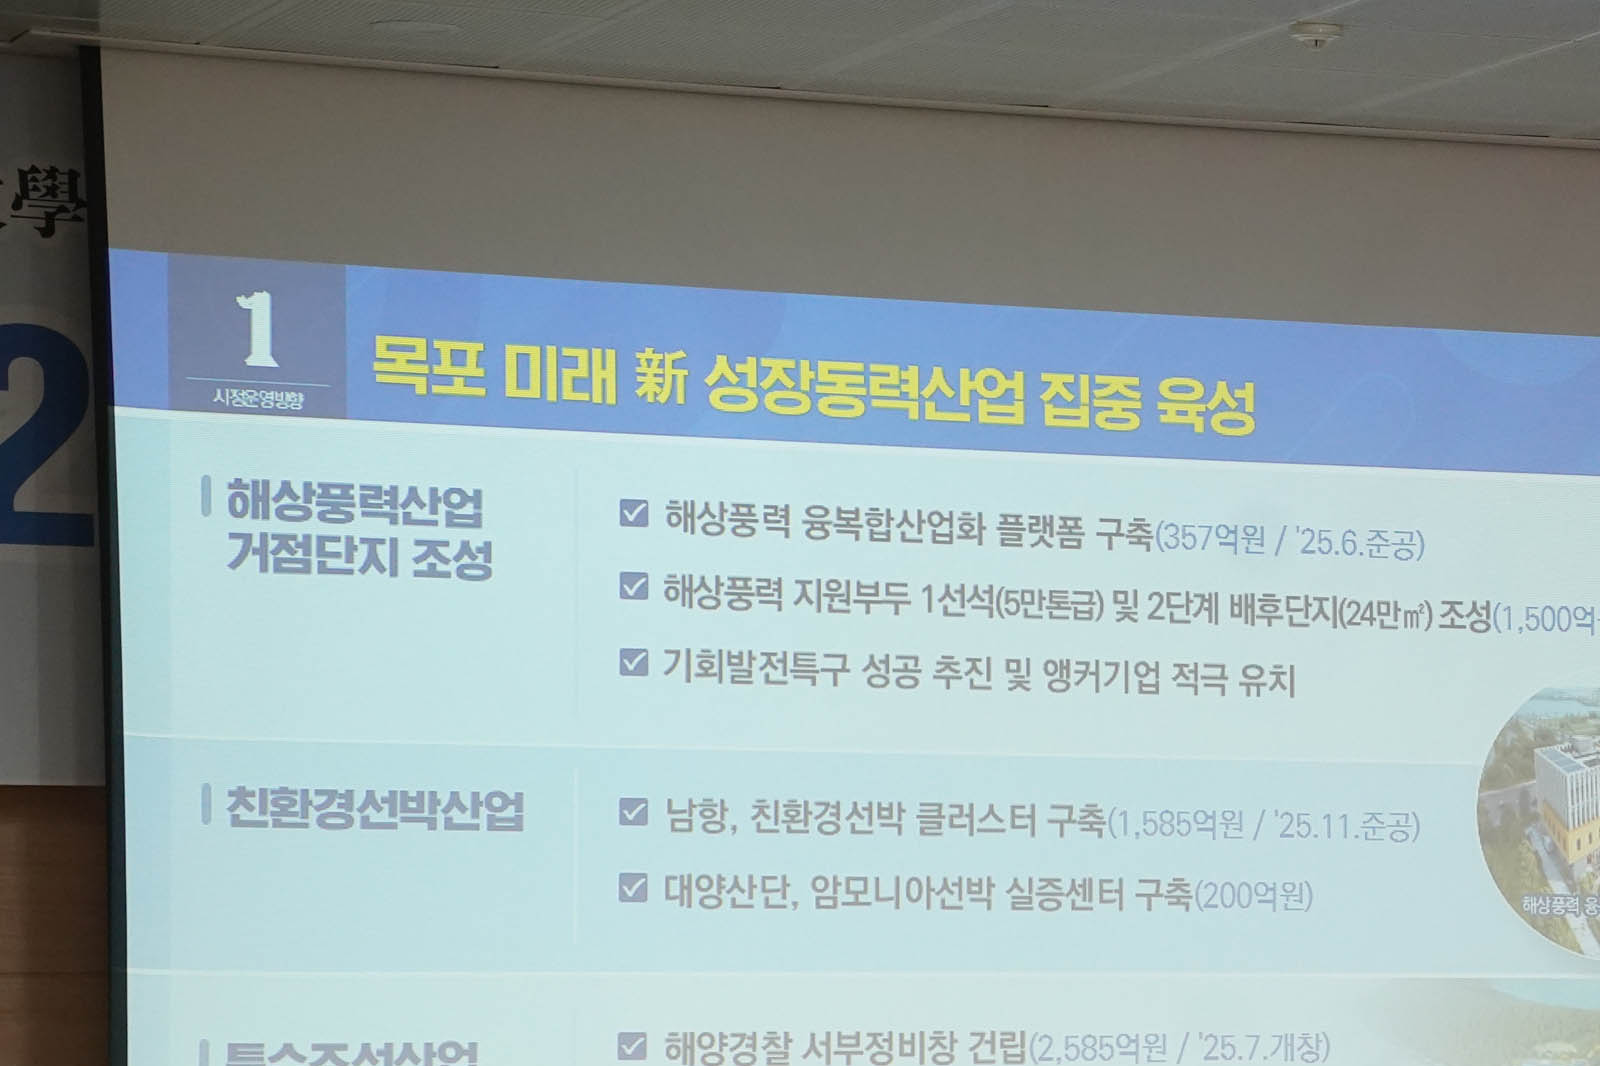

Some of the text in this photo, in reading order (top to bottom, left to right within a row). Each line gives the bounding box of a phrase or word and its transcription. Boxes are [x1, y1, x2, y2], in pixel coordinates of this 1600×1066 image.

[0, 163, 88, 239] 學
[235, 290, 280, 368] 1
[373, 335, 1256, 437] 목포 미래 新 성장동력산업 집중 육성
[227, 478, 483, 529] 해상풍력산업
[665, 499, 791, 541] 해상풍력
[801, 502, 986, 545] 융복합산업화
[996, 510, 1086, 550] 플랫폼
[1096, 515, 1266, 557] 구축(357억원
[227, 532, 493, 582] 거점단지 조성
[663, 572, 784, 613] 해상풍력
[793, 577, 912, 616] 지원부두
[921, 583, 1104, 624] 1선석(5만톤급)
[1113, 587, 1140, 623] 및
[1147, 588, 1219, 626] 2단계
[663, 647, 1296, 698] 기회발전특구 성공 추진 및 앵커기업 적극 유치
[226, 785, 524, 832] 친환경선박산업
[665, 797, 737, 837] 남항,
[750, 798, 905, 838] 친환경선박
[916, 800, 1037, 838] 클러스터
[664, 872, 1313, 913] 대양산단, 암모니아선박 실증센터 구축(200억원)
[1522, 894, 1580, 916] 해상풍력
[801, 1031, 960, 1066] 서부정비창
